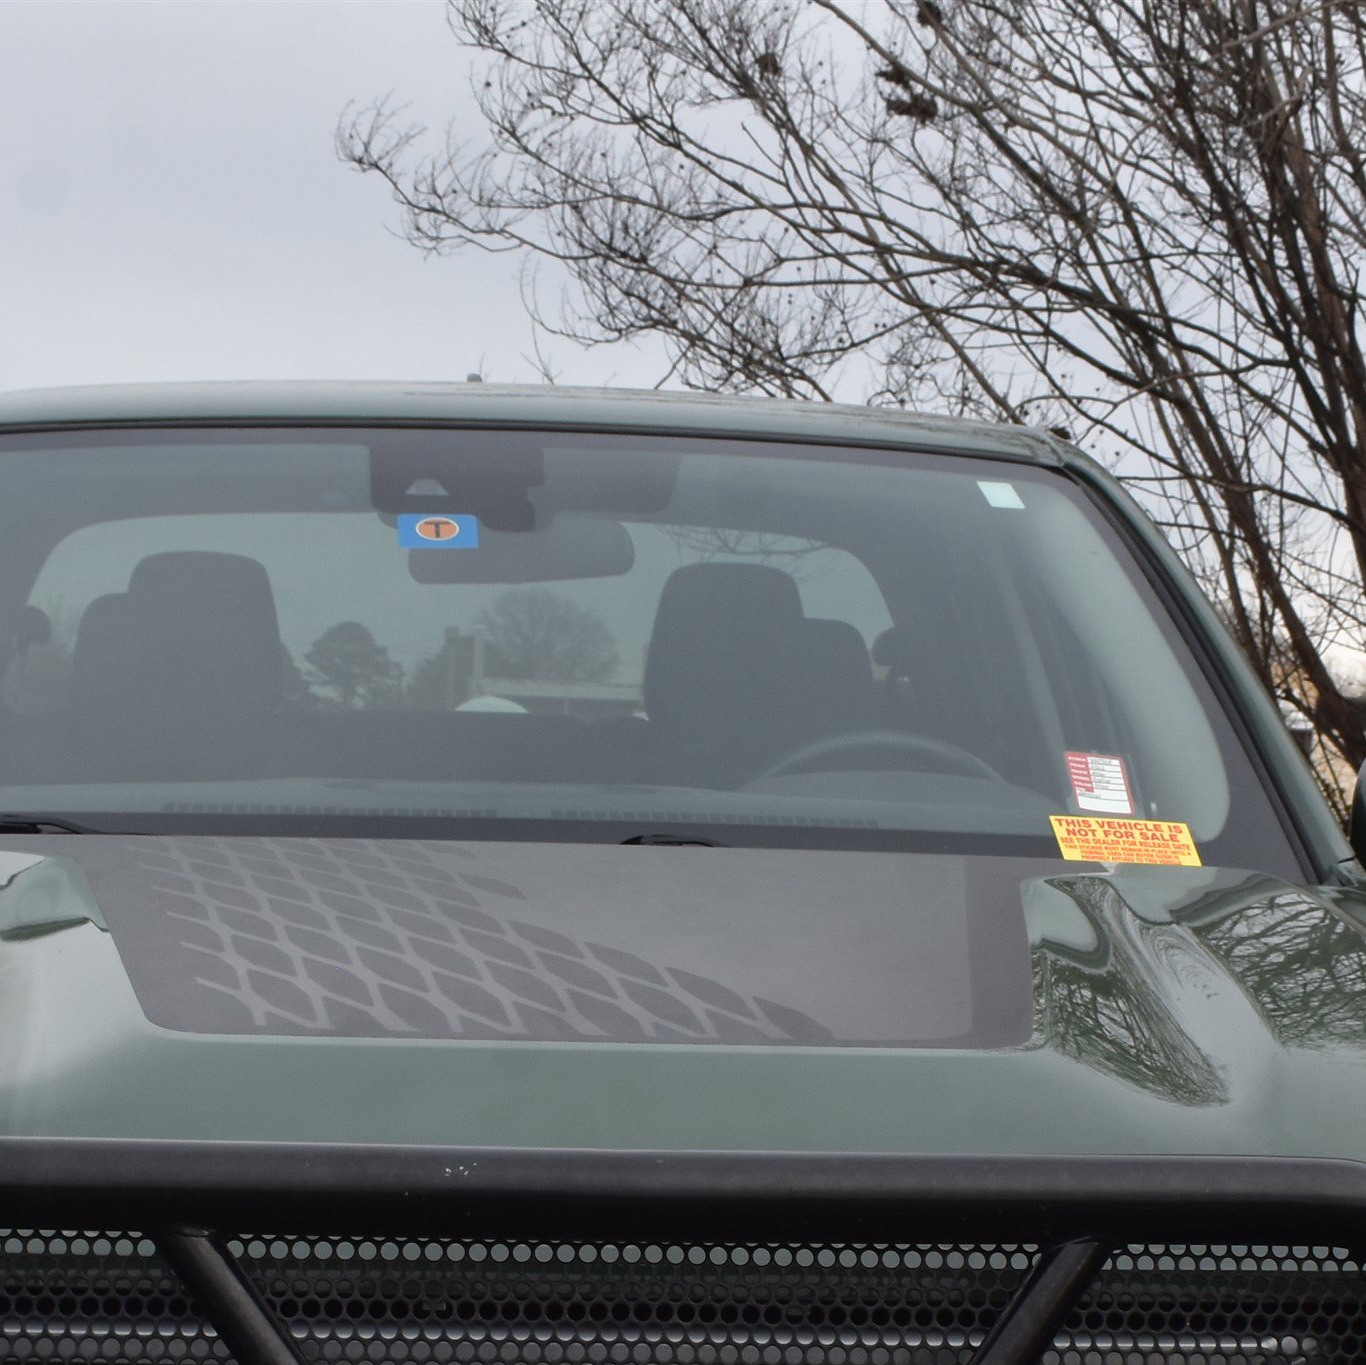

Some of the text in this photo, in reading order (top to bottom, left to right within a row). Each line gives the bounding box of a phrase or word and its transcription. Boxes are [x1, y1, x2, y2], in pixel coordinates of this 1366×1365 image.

[424, 521, 451, 537] T
[1054, 818, 1183, 834] THIS VEHICLE IS
[1065, 828, 1180, 843] NOT FOR SALE
